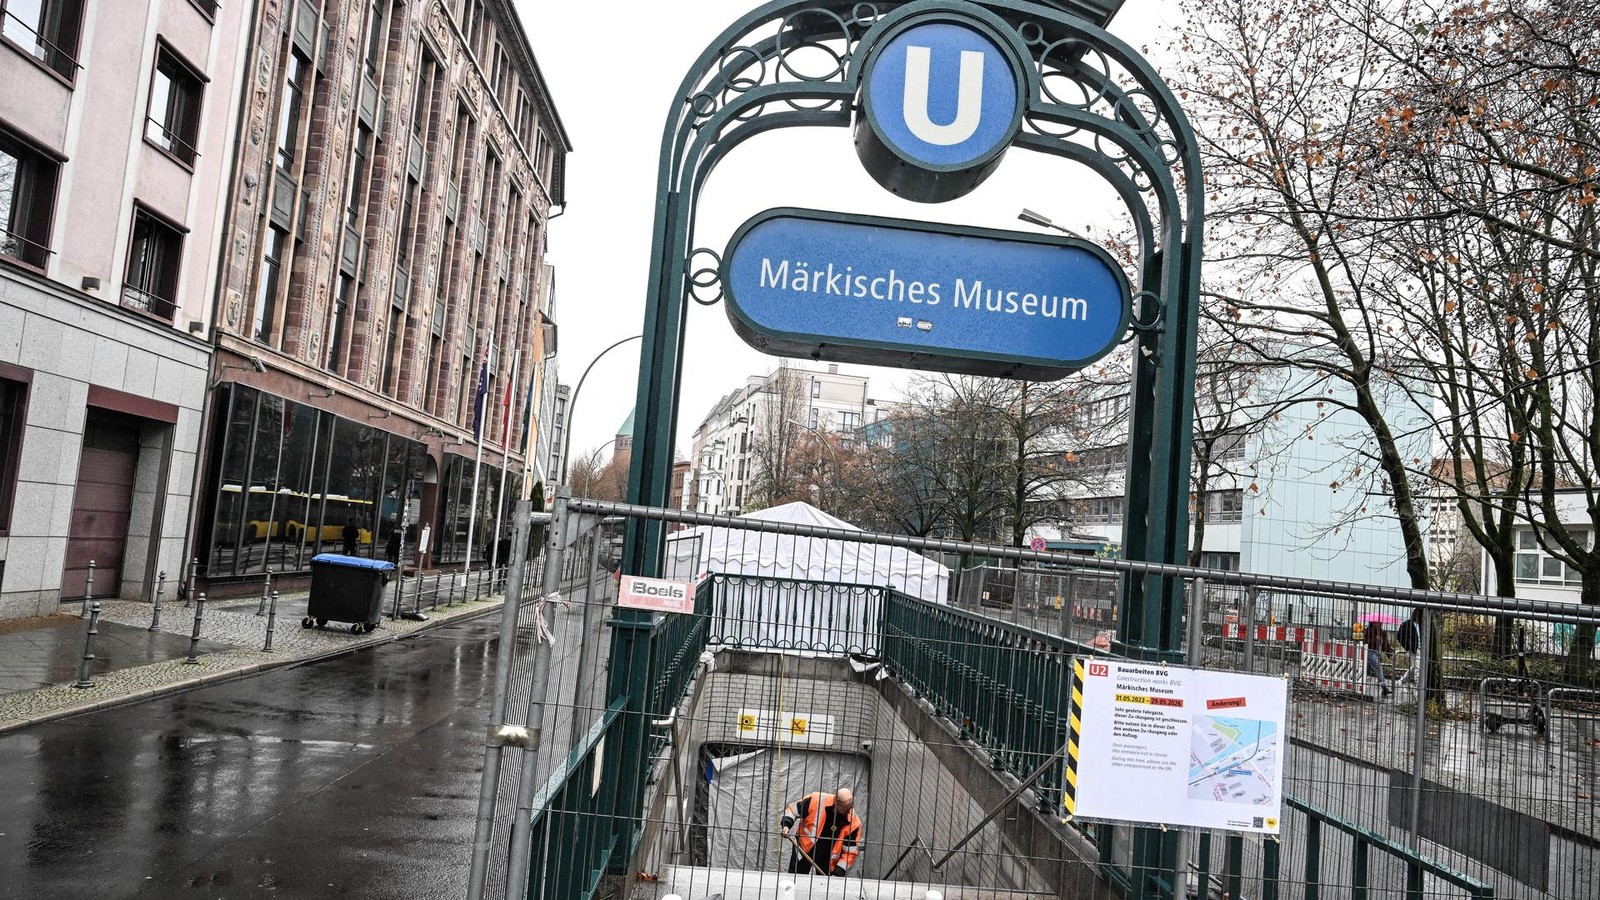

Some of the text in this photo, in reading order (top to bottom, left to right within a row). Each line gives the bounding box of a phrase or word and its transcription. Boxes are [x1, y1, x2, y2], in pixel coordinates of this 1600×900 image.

[903, 46, 984, 146] U
[759, 258, 1088, 322] Märkisches Museum
[632, 581, 684, 598] Boels
[1091, 666, 1107, 676] U2
[1118, 666, 1154, 675] Bauarbeiten
[1116, 684, 1148, 692] Märkisches
[1116, 695, 1145, 703] 31.05.2023
[1151, 698, 1180, 706] 29.05.2026
